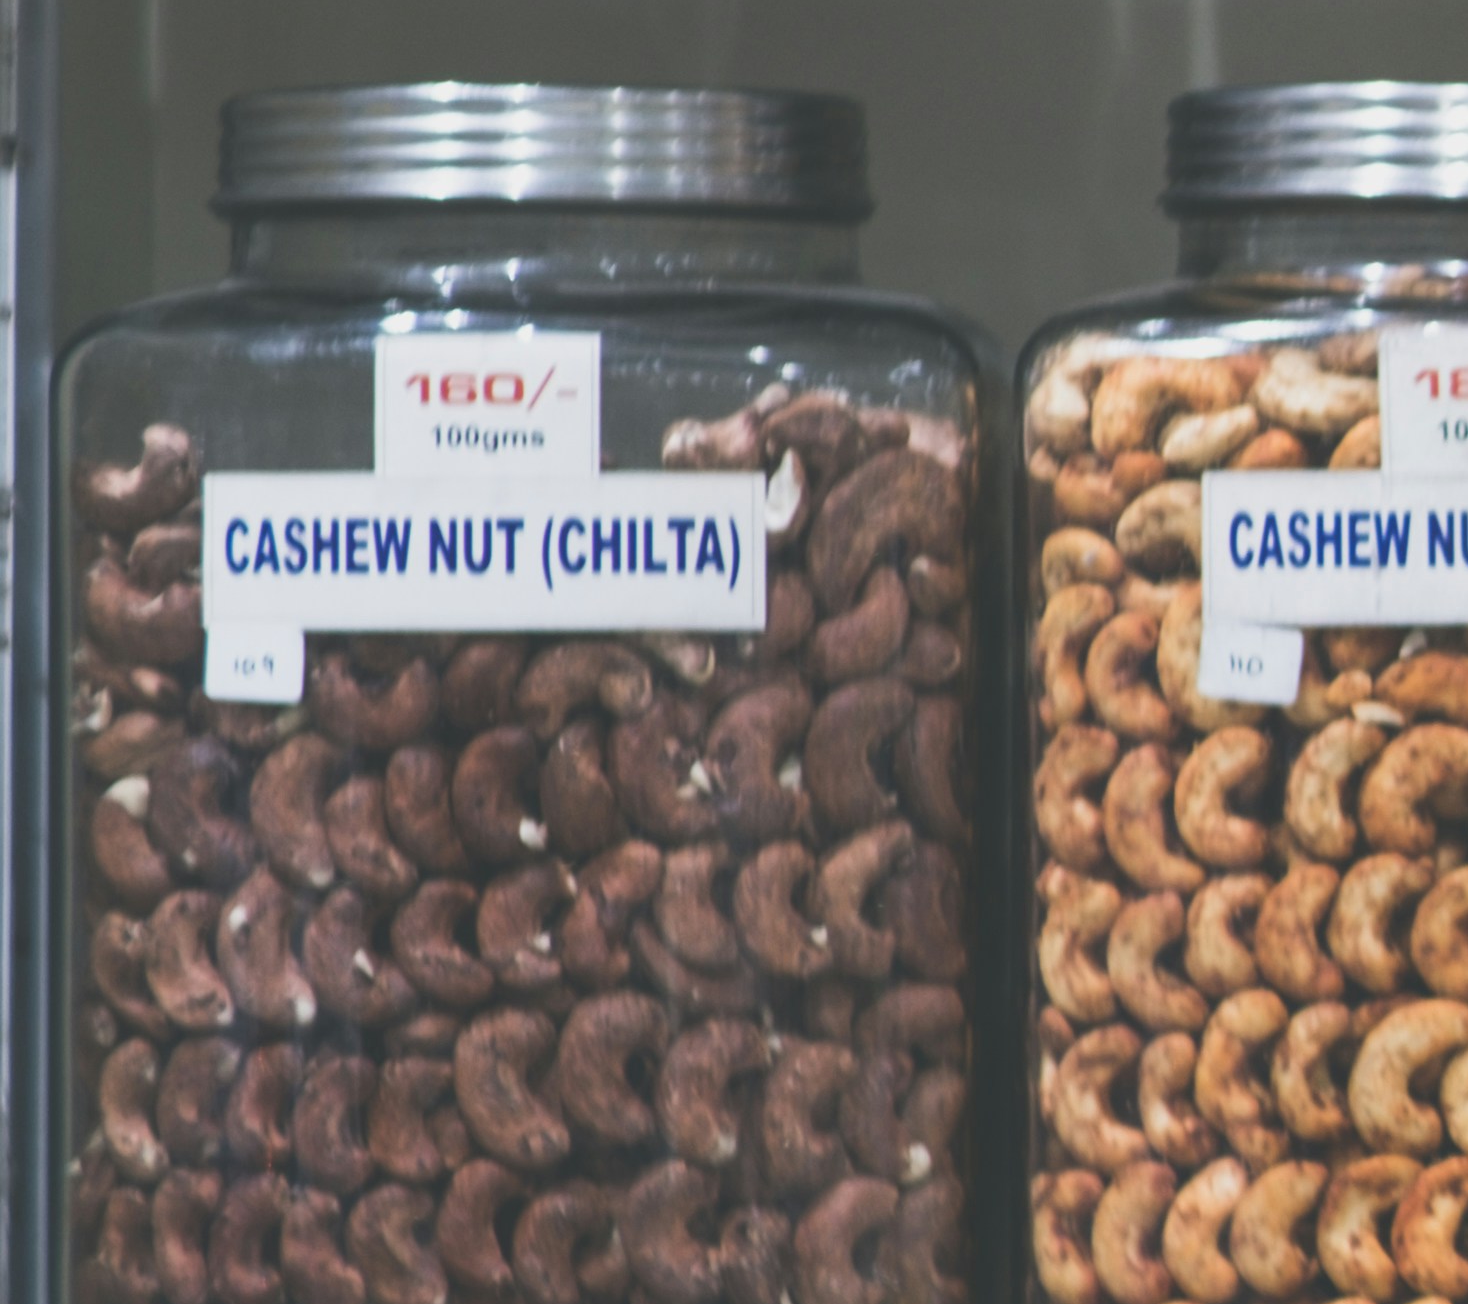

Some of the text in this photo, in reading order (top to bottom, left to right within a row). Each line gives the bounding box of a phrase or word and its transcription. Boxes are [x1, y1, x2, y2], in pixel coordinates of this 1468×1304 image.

[404, 364, 579, 410] 160/-
[435, 425, 545, 453] 100gms
[225, 517, 741, 591] CASHEW NUT (CHILTA)
[1229, 510, 1412, 570] CASHEW
